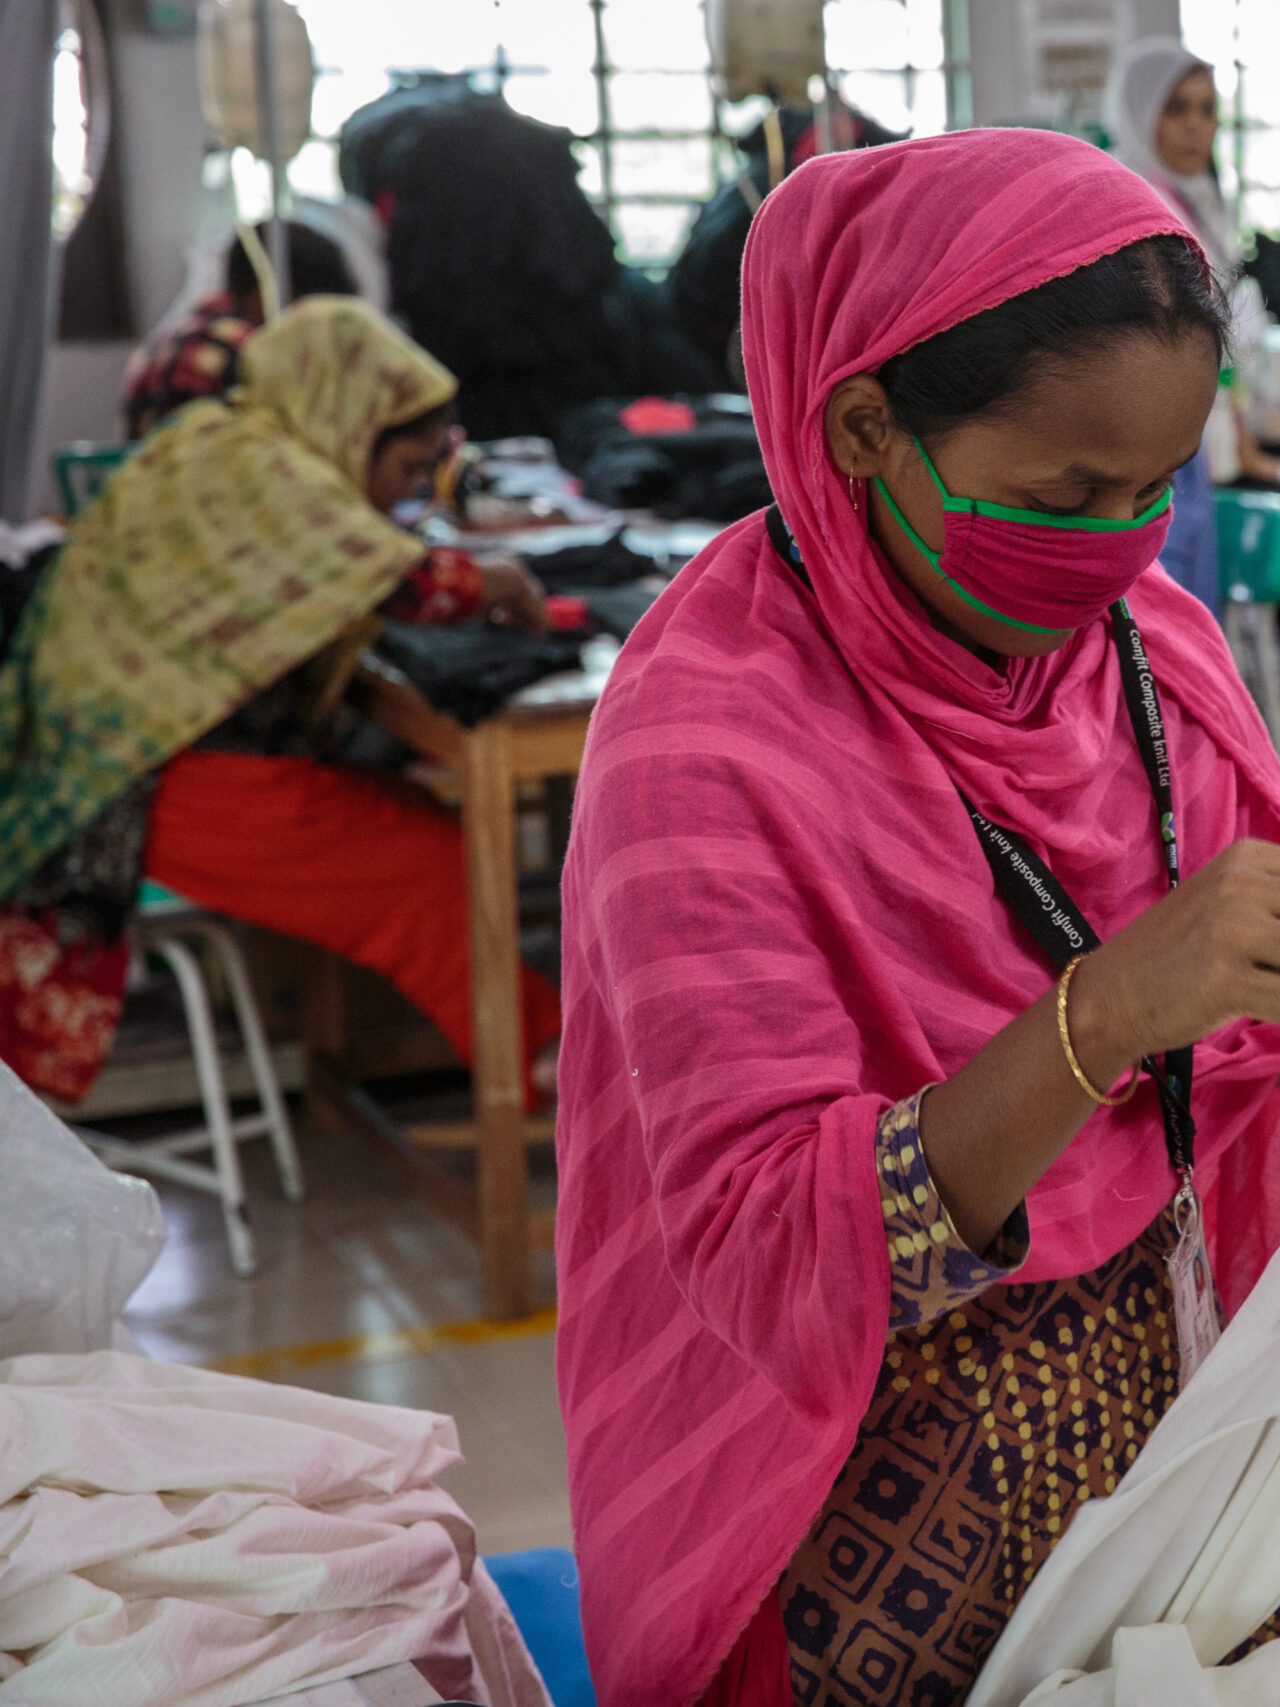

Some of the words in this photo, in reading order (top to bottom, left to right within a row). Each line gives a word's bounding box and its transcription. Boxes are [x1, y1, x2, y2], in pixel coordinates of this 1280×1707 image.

[1130, 629, 1149, 671] Comfit
[1139, 673, 1164, 738] Composite
[1153, 738, 1169, 764] knit
[1158, 765, 1171, 787] Ltd
[989, 829, 1013, 855] knit
[1010, 852, 1056, 910] Composite
[1050, 909, 1084, 949] Comfit
